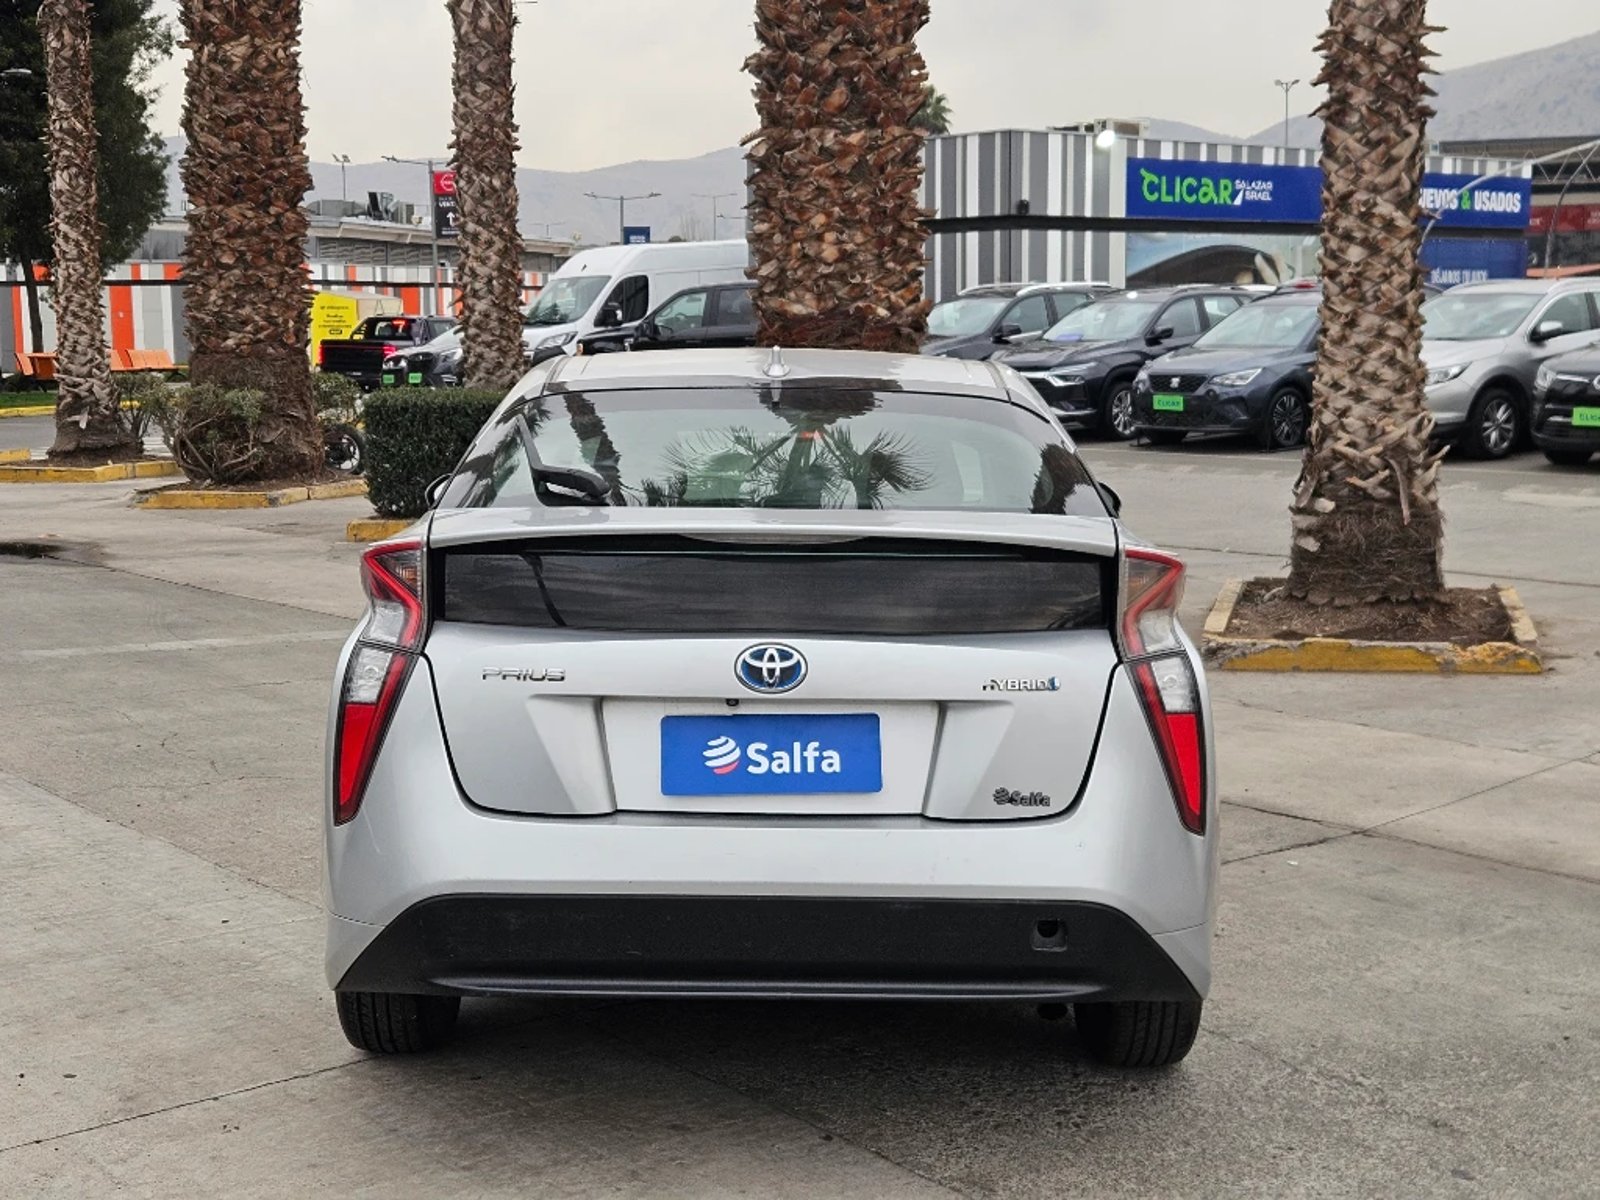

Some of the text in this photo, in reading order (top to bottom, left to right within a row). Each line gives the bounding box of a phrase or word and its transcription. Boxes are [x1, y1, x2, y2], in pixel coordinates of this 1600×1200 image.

[1461, 189, 1471, 210] &
[1474, 190, 1521, 213] USADOS
[482, 666, 566, 682] PRIUS
[982, 679, 1048, 692] HYBRID
[746, 741, 841, 774] Salfa
[1010, 790, 1051, 807] Salfa
